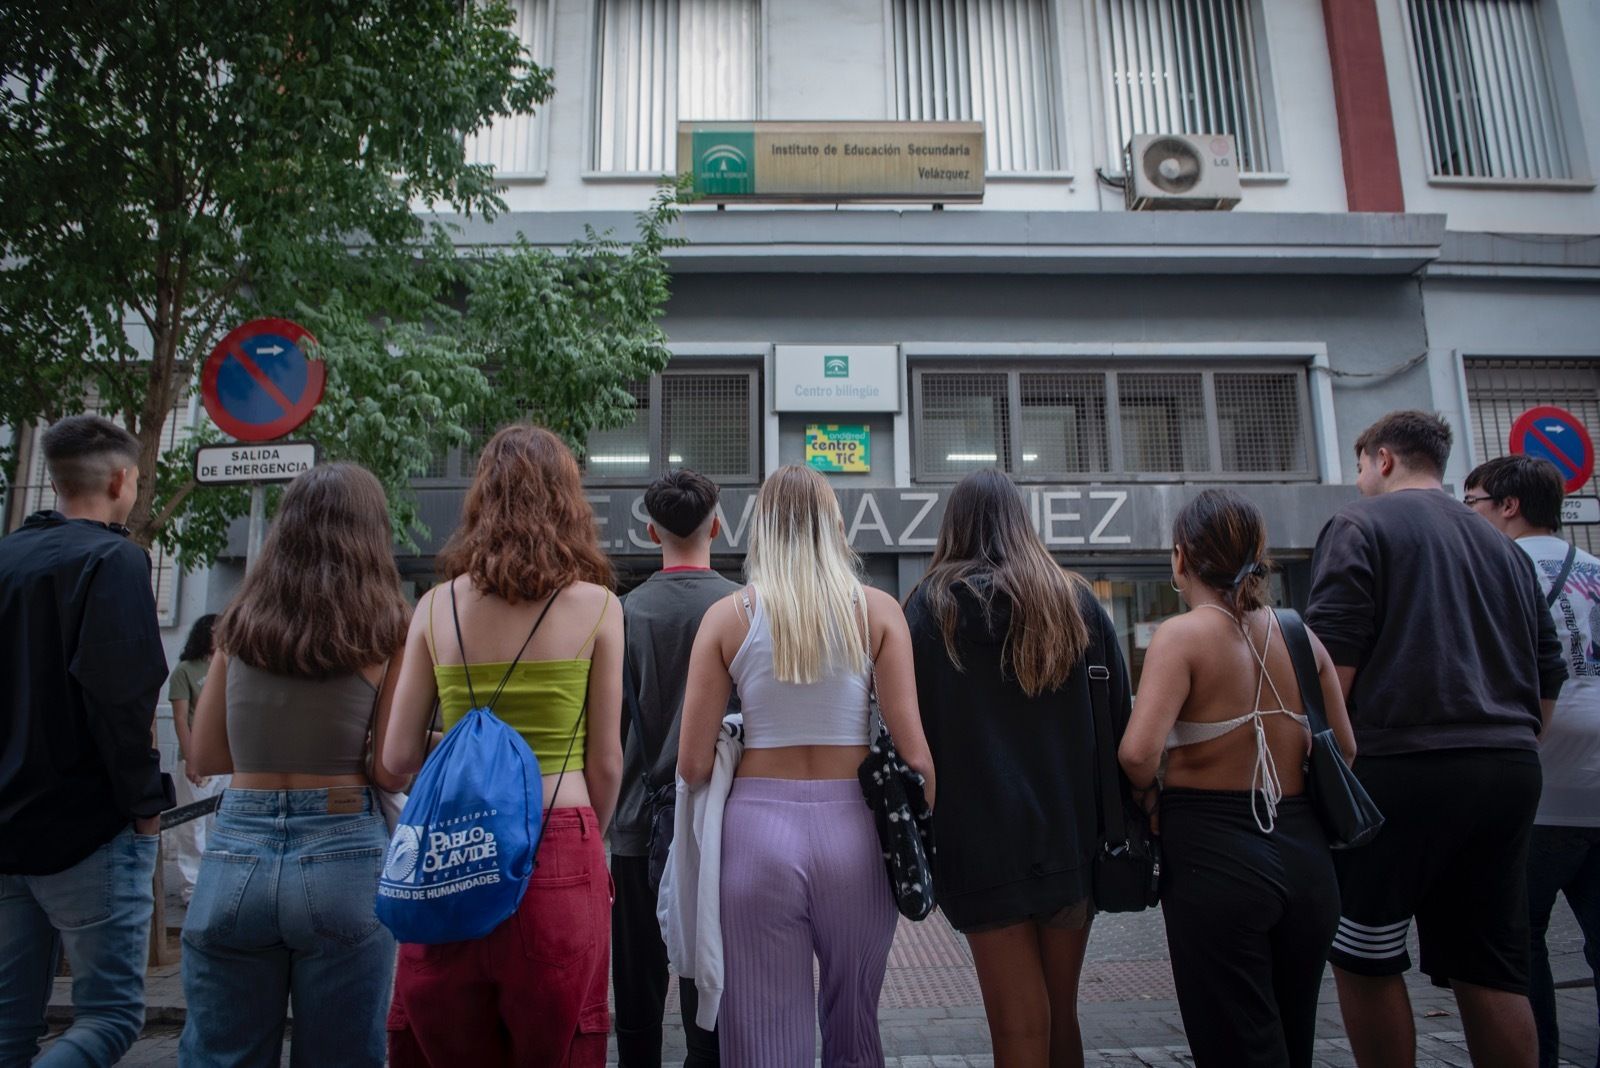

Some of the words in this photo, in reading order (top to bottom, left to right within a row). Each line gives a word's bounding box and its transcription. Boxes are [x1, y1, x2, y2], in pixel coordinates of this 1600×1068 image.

[771, 143, 820, 156] Instituto
[823, 144, 838, 156] de
[844, 143, 901, 156] Educación
[907, 143, 971, 156] Secundaria
[1213, 158, 1229, 167] LG
[918, 166, 970, 181] Velázquez
[794, 384, 833, 397] Centro
[835, 384, 880, 399] bilingüe
[811, 440, 857, 451] centro
[231, 449, 280, 461] SALIDA
[201, 465, 218, 477] DE
[224, 461, 308, 476] EMERGENCIA
[428, 826, 485, 854] PABLO
[422, 841, 498, 873] OLAVIDE
[412, 890, 426, 900] DE
[427, 873, 501, 899] HUMANIDADES
